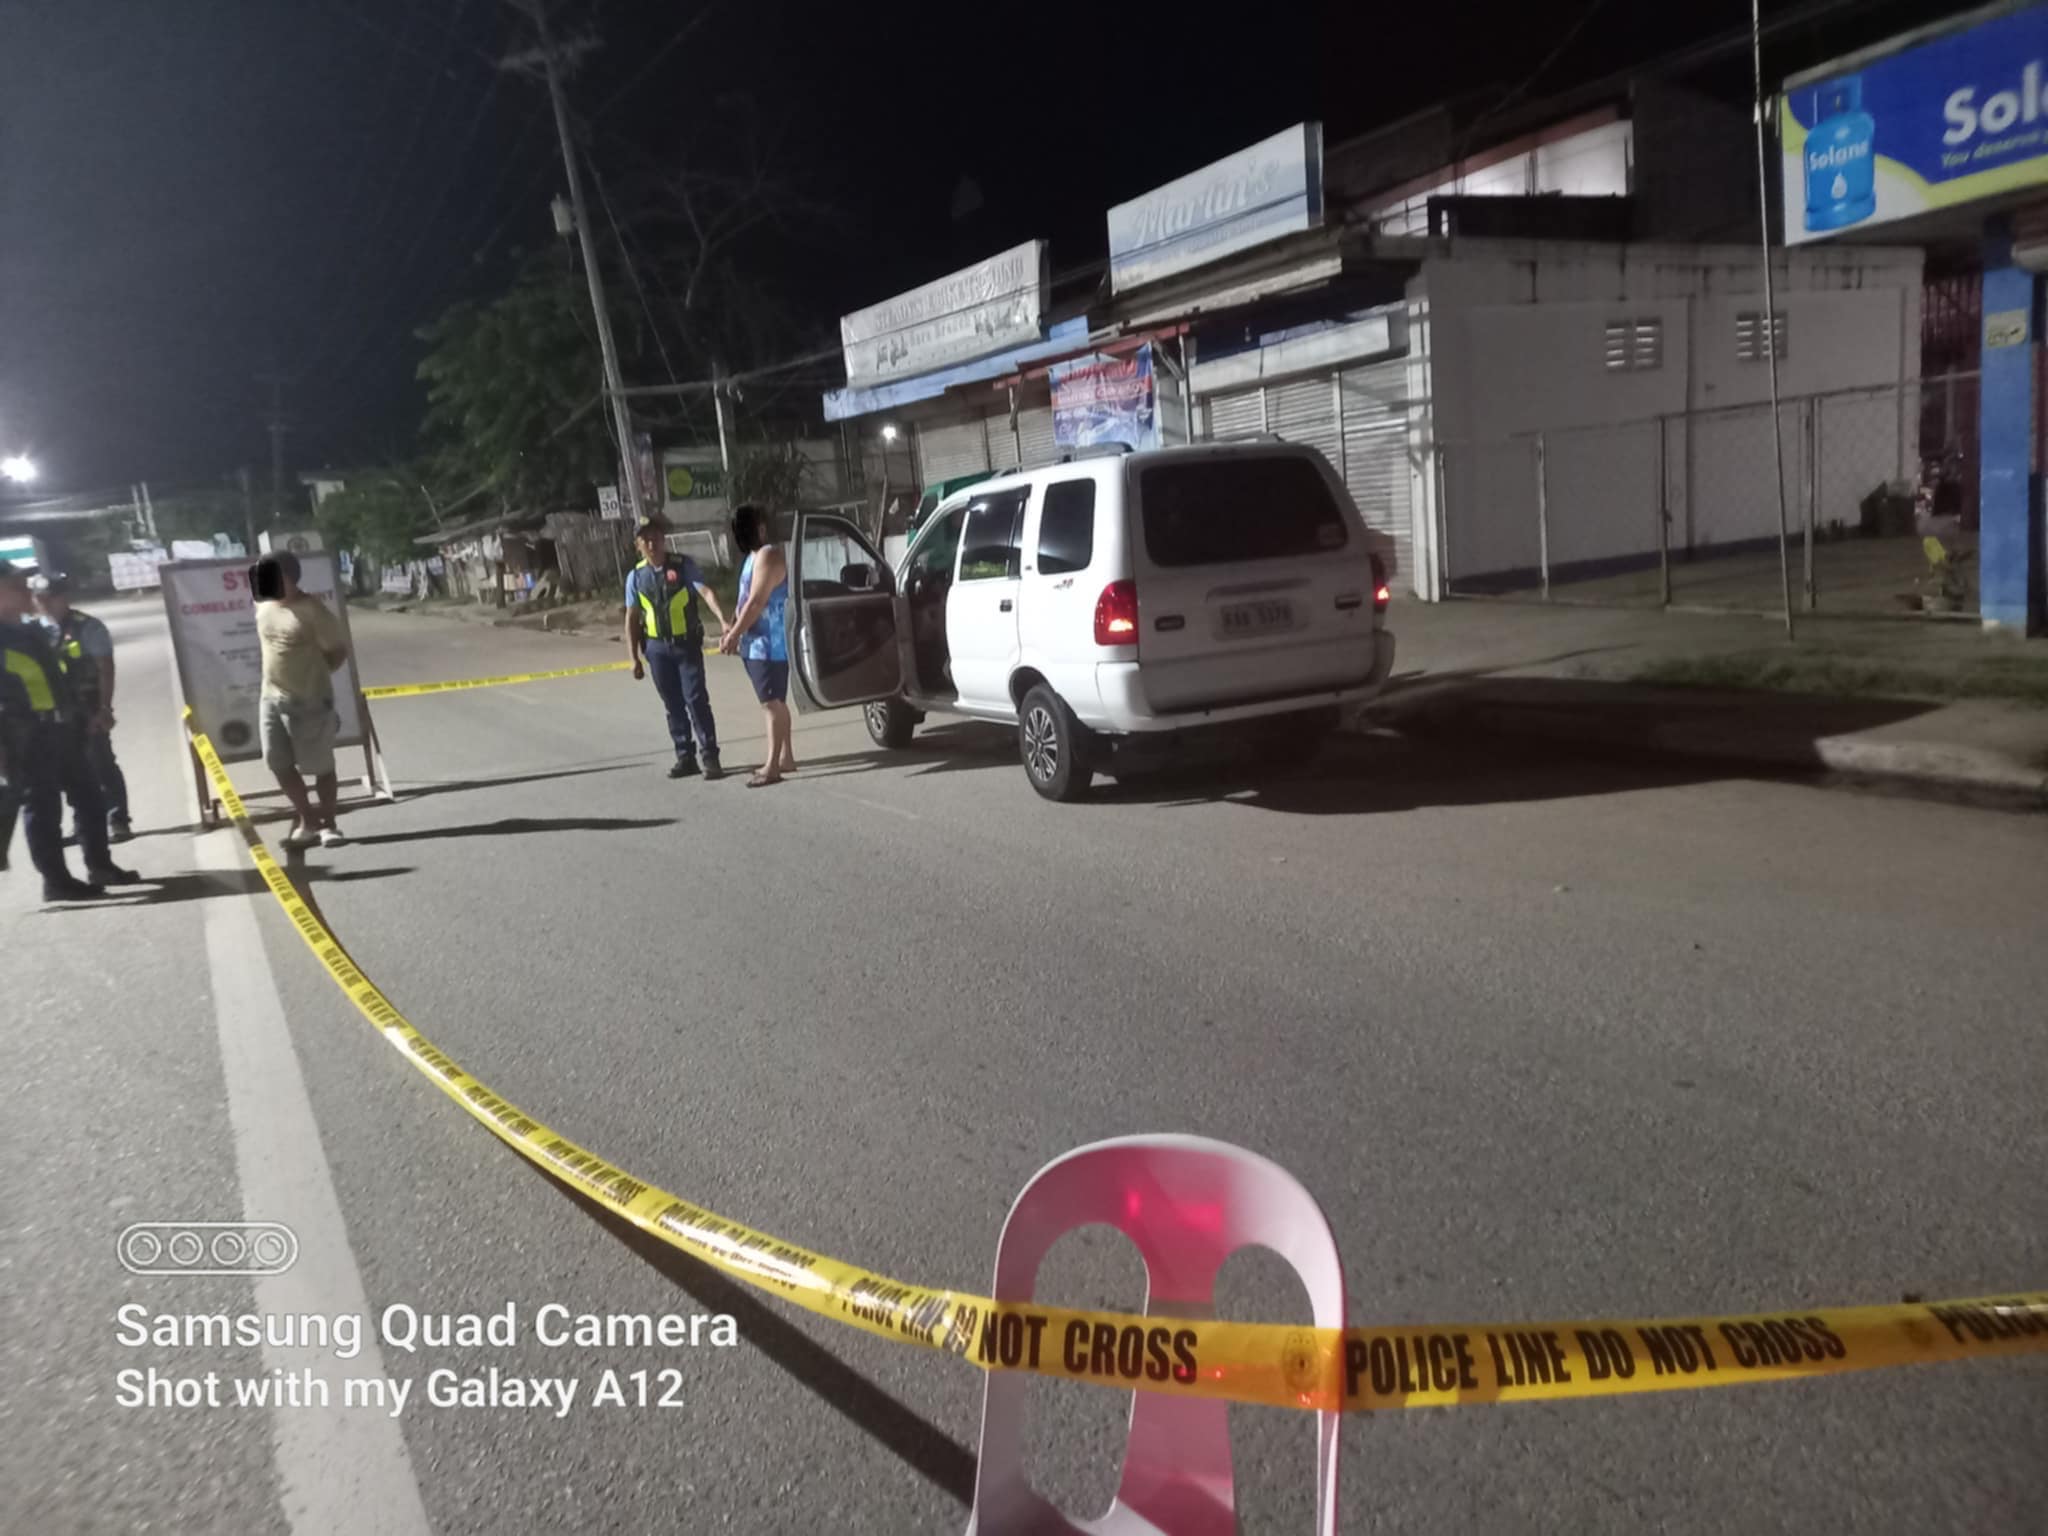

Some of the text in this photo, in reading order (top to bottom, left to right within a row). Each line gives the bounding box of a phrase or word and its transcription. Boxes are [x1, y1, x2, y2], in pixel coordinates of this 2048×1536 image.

[1942, 61, 2048, 145] Sol
[978, 1311, 1047, 1369] NOT
[1063, 1319, 1198, 1384] CROSS
[1345, 1316, 1847, 1396] POLICE LINE DO NOT CROSS
